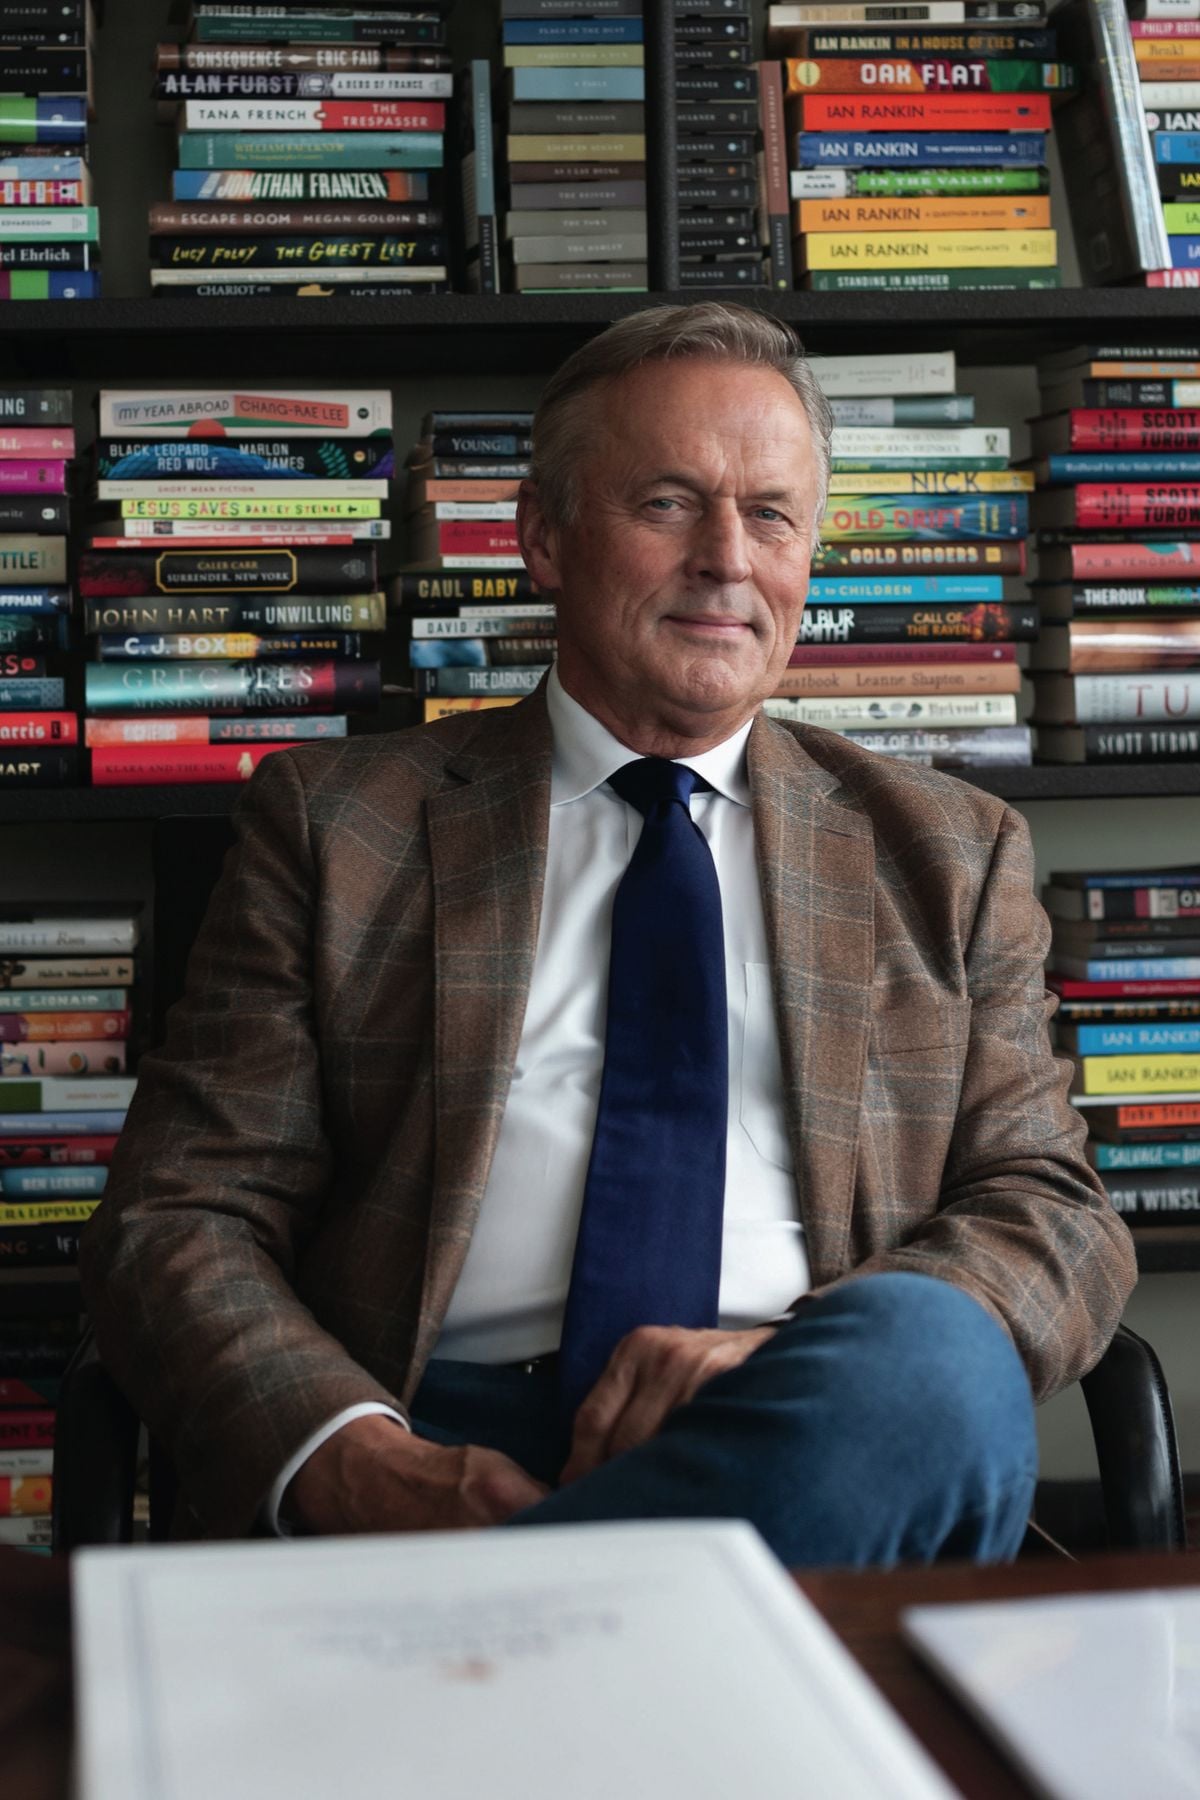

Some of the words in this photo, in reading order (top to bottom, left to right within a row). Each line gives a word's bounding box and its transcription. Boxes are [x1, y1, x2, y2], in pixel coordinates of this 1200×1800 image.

[815, 37, 837, 49] IAN
[840, 37, 891, 49] RANKIN
[187, 51, 281, 68] CONSEQUENCE
[316, 51, 347, 66] ERIC
[860, 63, 912, 84] OAK
[922, 63, 984, 85] FLAT
[165, 76, 224, 93] ALAN
[227, 76, 295, 93] FURST
[199, 110, 240, 120] TANA
[248, 110, 306, 119] FRENCH
[372, 104, 397, 113] THE
[827, 106, 855, 118] IAN
[861, 105, 924, 118] RANKIN
[343, 117, 428, 126] TRESPASSER
[819, 143, 847, 157] IAN
[854, 142, 918, 156] RANKIN
[216, 173, 303, 198] JONATHAN
[310, 173, 387, 197] FRANZEN
[870, 177, 889, 186] IN
[895, 176, 926, 186] THE
[930, 176, 1006, 186] VALLEY
[181, 214, 236, 224] ESCAPE
[243, 213, 291, 224] ROOM
[303, 215, 350, 223] MEGAN
[358, 215, 410, 223] GOLDIN
[822, 208, 850, 221] IAN
[857, 207, 920, 220] RANKIN
[20, 249, 70, 261] Ehrlich
[172, 246, 206, 262] LUCY
[212, 246, 257, 262] FOLEY
[276, 246, 303, 259] THE
[308, 242, 375, 260] GUEST
[379, 242, 416, 260] LIST
[831, 245, 859, 257] IAN
[865, 243, 928, 256] RANKIN
[838, 276, 886, 287] STANDING
[891, 275, 900, 287] IN
[904, 275, 949, 286] ANOTHER
[197, 285, 254, 296] CHARIOT
[118, 406, 140, 420] MY
[143, 403, 175, 417] YEAR
[179, 400, 230, 414] ABROAD
[240, 400, 317, 419] CHANG-RAE
[322, 408, 343, 421] LEE
[1143, 413, 1196, 428] SCOTT
[110, 444, 150, 457] BLACK
[154, 444, 209, 456] LEOPARD
[240, 444, 288, 455] MARLON
[452, 438, 500, 451] YOUNG
[158, 458, 181, 470] RED
[187, 458, 218, 470] WOLF
[264, 457, 304, 470] JAMES
[910, 471, 981, 492] NICK
[1146, 489, 1199, 504] SCOTT
[127, 502, 180, 515] JESUS
[188, 501, 239, 515] SAVES
[246, 505, 290, 514] DARCEY
[833, 510, 884, 530] OLD
[893, 509, 963, 529] DRIFT
[850, 548, 897, 564] GOLD
[902, 547, 978, 563] DIGGERS
[197, 561, 227, 570] CALEB
[235, 572, 256, 581] NEW
[258, 571, 290, 581] YORK
[419, 580, 464, 597] CAUL
[473, 579, 517, 596] BABY
[839, 584, 913, 596] CHILDREN
[1084, 588, 1146, 605] THEROUX
[94, 608, 157, 625] JOHN
[168, 607, 229, 624] HART
[242, 611, 260, 620] THE
[266, 605, 352, 624] UNWILLING
[913, 612, 942, 623] CALL
[428, 622, 467, 634] DAVID
[475, 622, 500, 633] JOY
[907, 625, 928, 635] THE
[931, 624, 971, 635] RAVEN
[124, 638, 145, 654] C.
[151, 638, 170, 654] J.
[178, 637, 227, 654] BOX
[267, 641, 297, 649] LONG
[301, 640, 338, 649] RANGE
[498, 640, 520, 649] THE
[123, 668, 218, 690] GREG
[240, 666, 314, 689] ILES
[469, 672, 488, 689] THE
[856, 673, 904, 687] Leanne
[911, 672, 964, 687] Shapton
[246, 694, 309, 707] BLOOD
[220, 724, 255, 737] JOE
[260, 723, 296, 735] IDE
[1098, 732, 1143, 753] SCOTT
[149, 764, 173, 773] AND
[177, 763, 198, 772] THE
[204, 763, 226, 772] SUN
[1103, 1032, 1133, 1045] IAN
[1107, 1069, 1136, 1081] IAN
